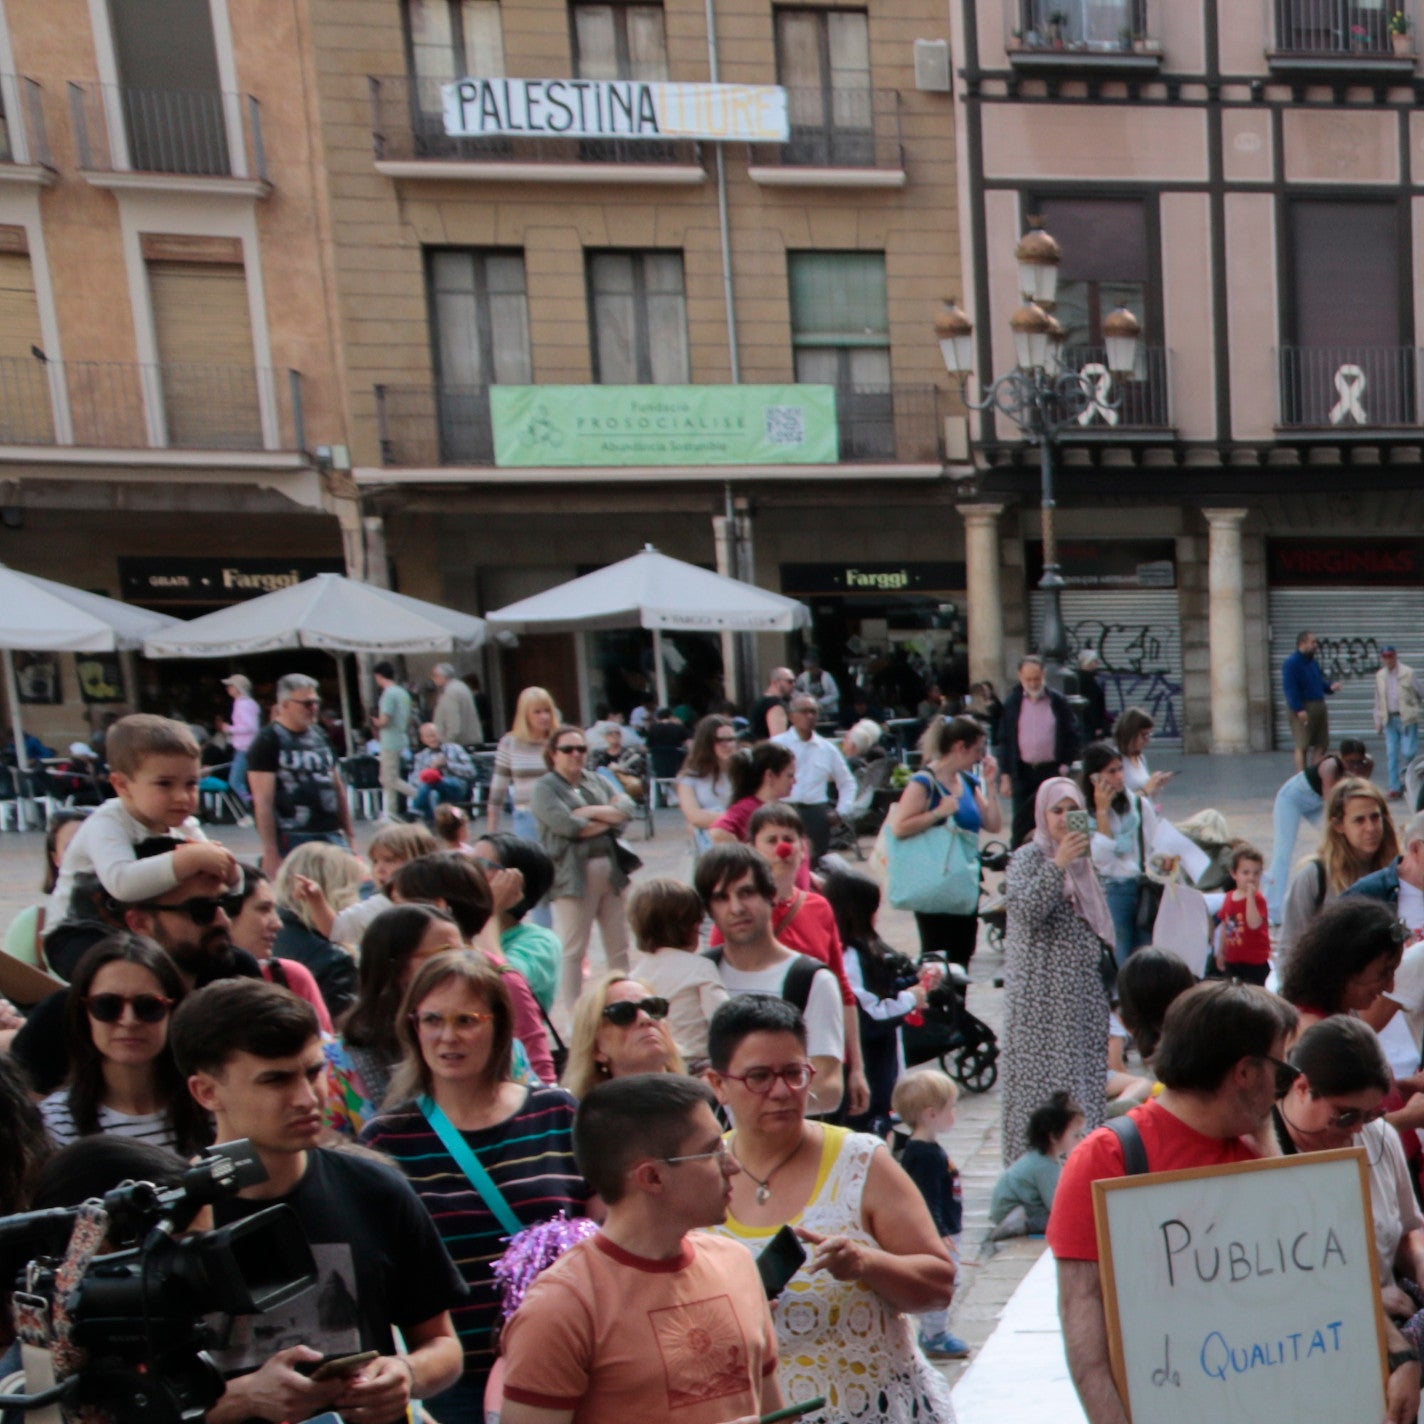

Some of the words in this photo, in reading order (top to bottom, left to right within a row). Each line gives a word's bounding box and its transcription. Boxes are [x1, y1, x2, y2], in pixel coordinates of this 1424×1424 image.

[846, 569, 908, 588] Farggi
[1159, 1218, 1347, 1287] PÚBLICA
[1151, 1334, 1182, 1388] de
[1201, 1321, 1343, 1382] QUALITAT
